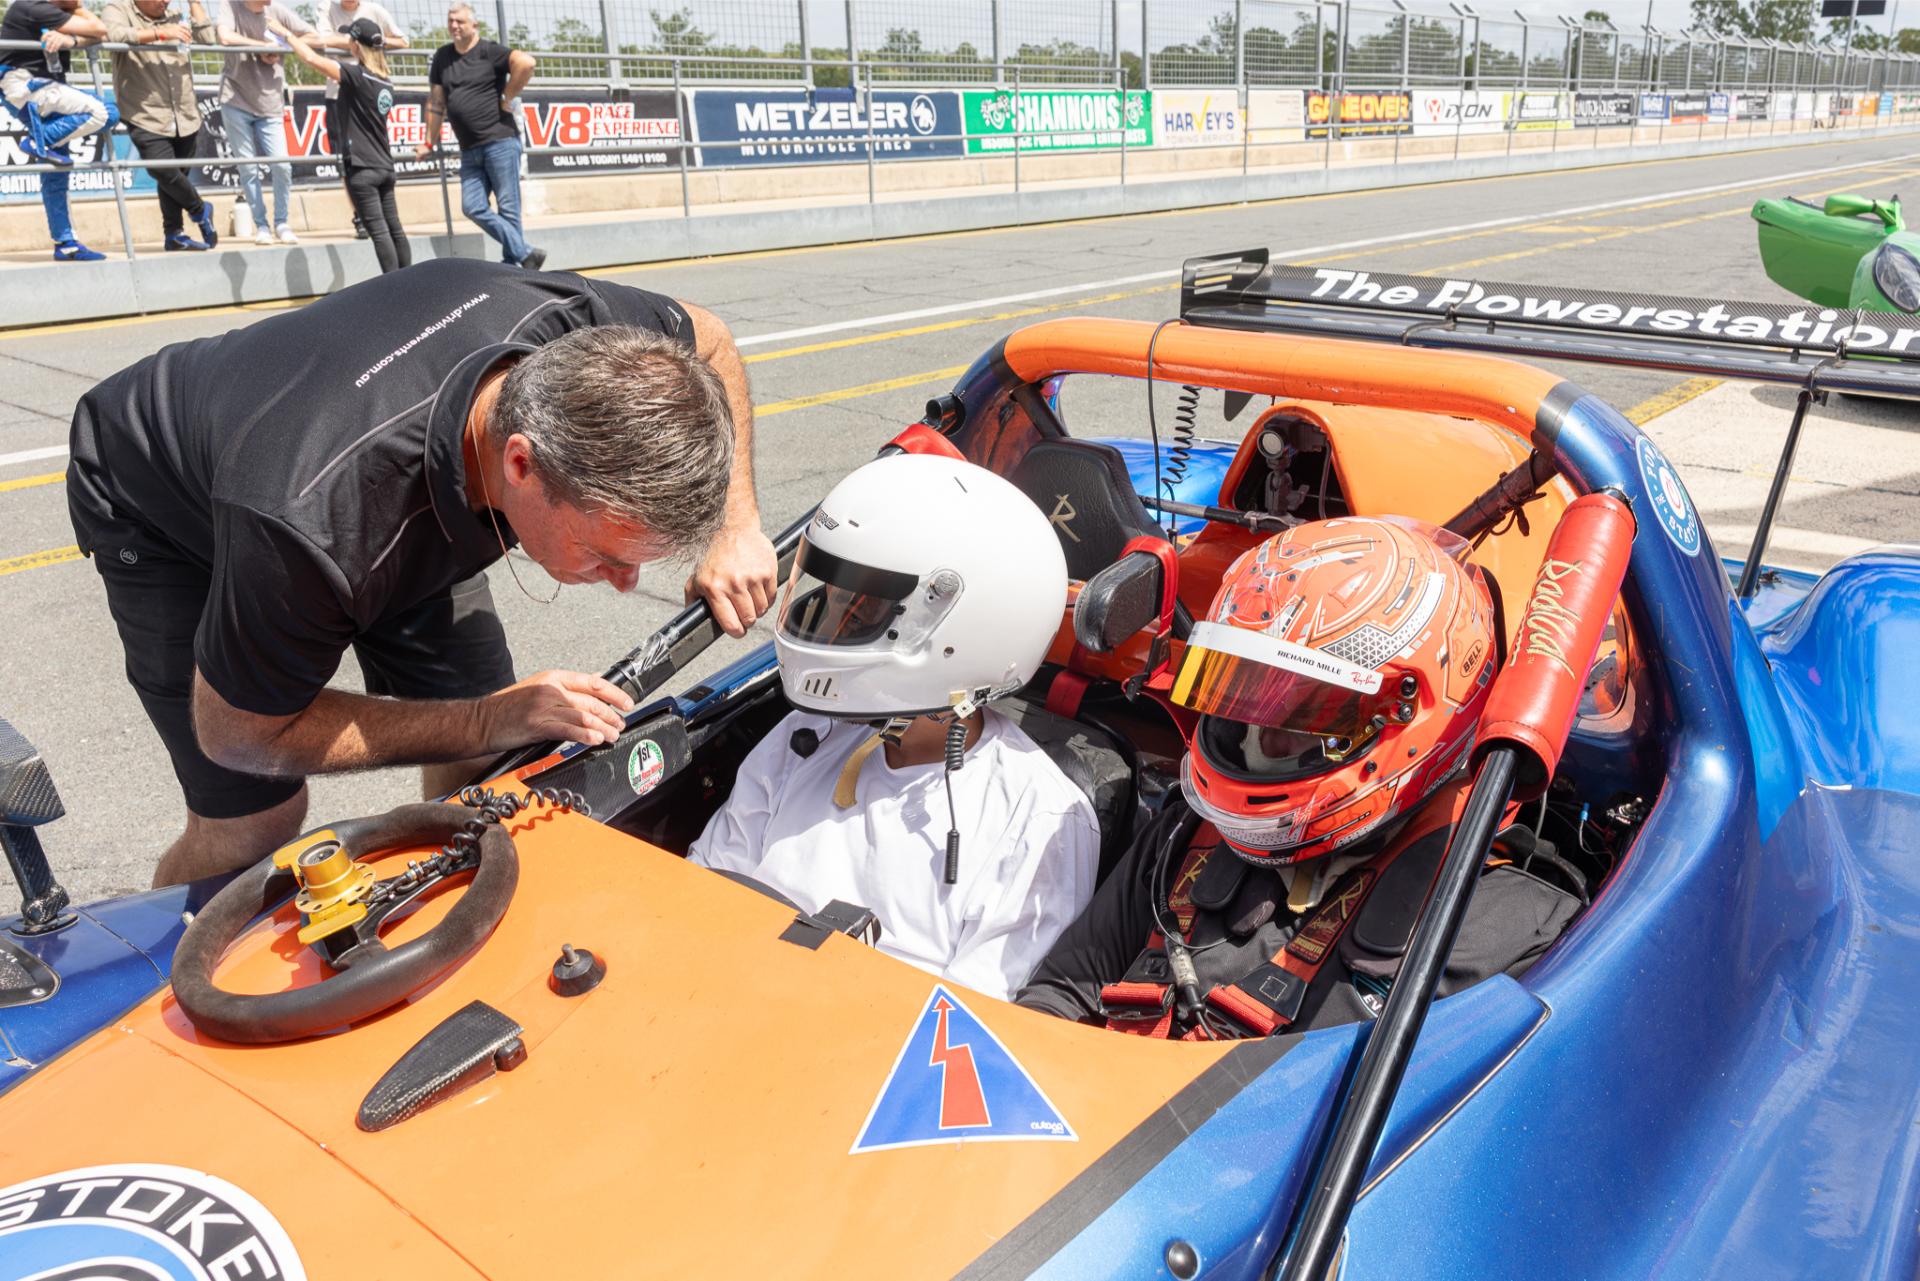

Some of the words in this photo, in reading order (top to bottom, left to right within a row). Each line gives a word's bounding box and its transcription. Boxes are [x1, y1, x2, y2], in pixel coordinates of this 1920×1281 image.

[523, 104, 591, 147] V8
[593, 105, 632, 119] RACE
[735, 102, 908, 132] METZELER
[1011, 95, 1120, 132] SHANNONS
[1165, 101, 1234, 133] HARVEY'S
[593, 121, 680, 135] EXPERIENCE
[739, 135, 856, 156] MOTORCYCLE
[316, 165, 339, 177] CAL
[553, 155, 576, 167] CALL
[577, 154, 589, 166] US
[1313, 268, 1416, 305] The
[355, 293, 490, 388] www.drivingevents.com.au
[1277, 650, 1315, 667] RICHARD
[1316, 662, 1342, 675] MILLE
[1463, 643, 1483, 673] BELL
[636, 742, 651, 771] 1st
